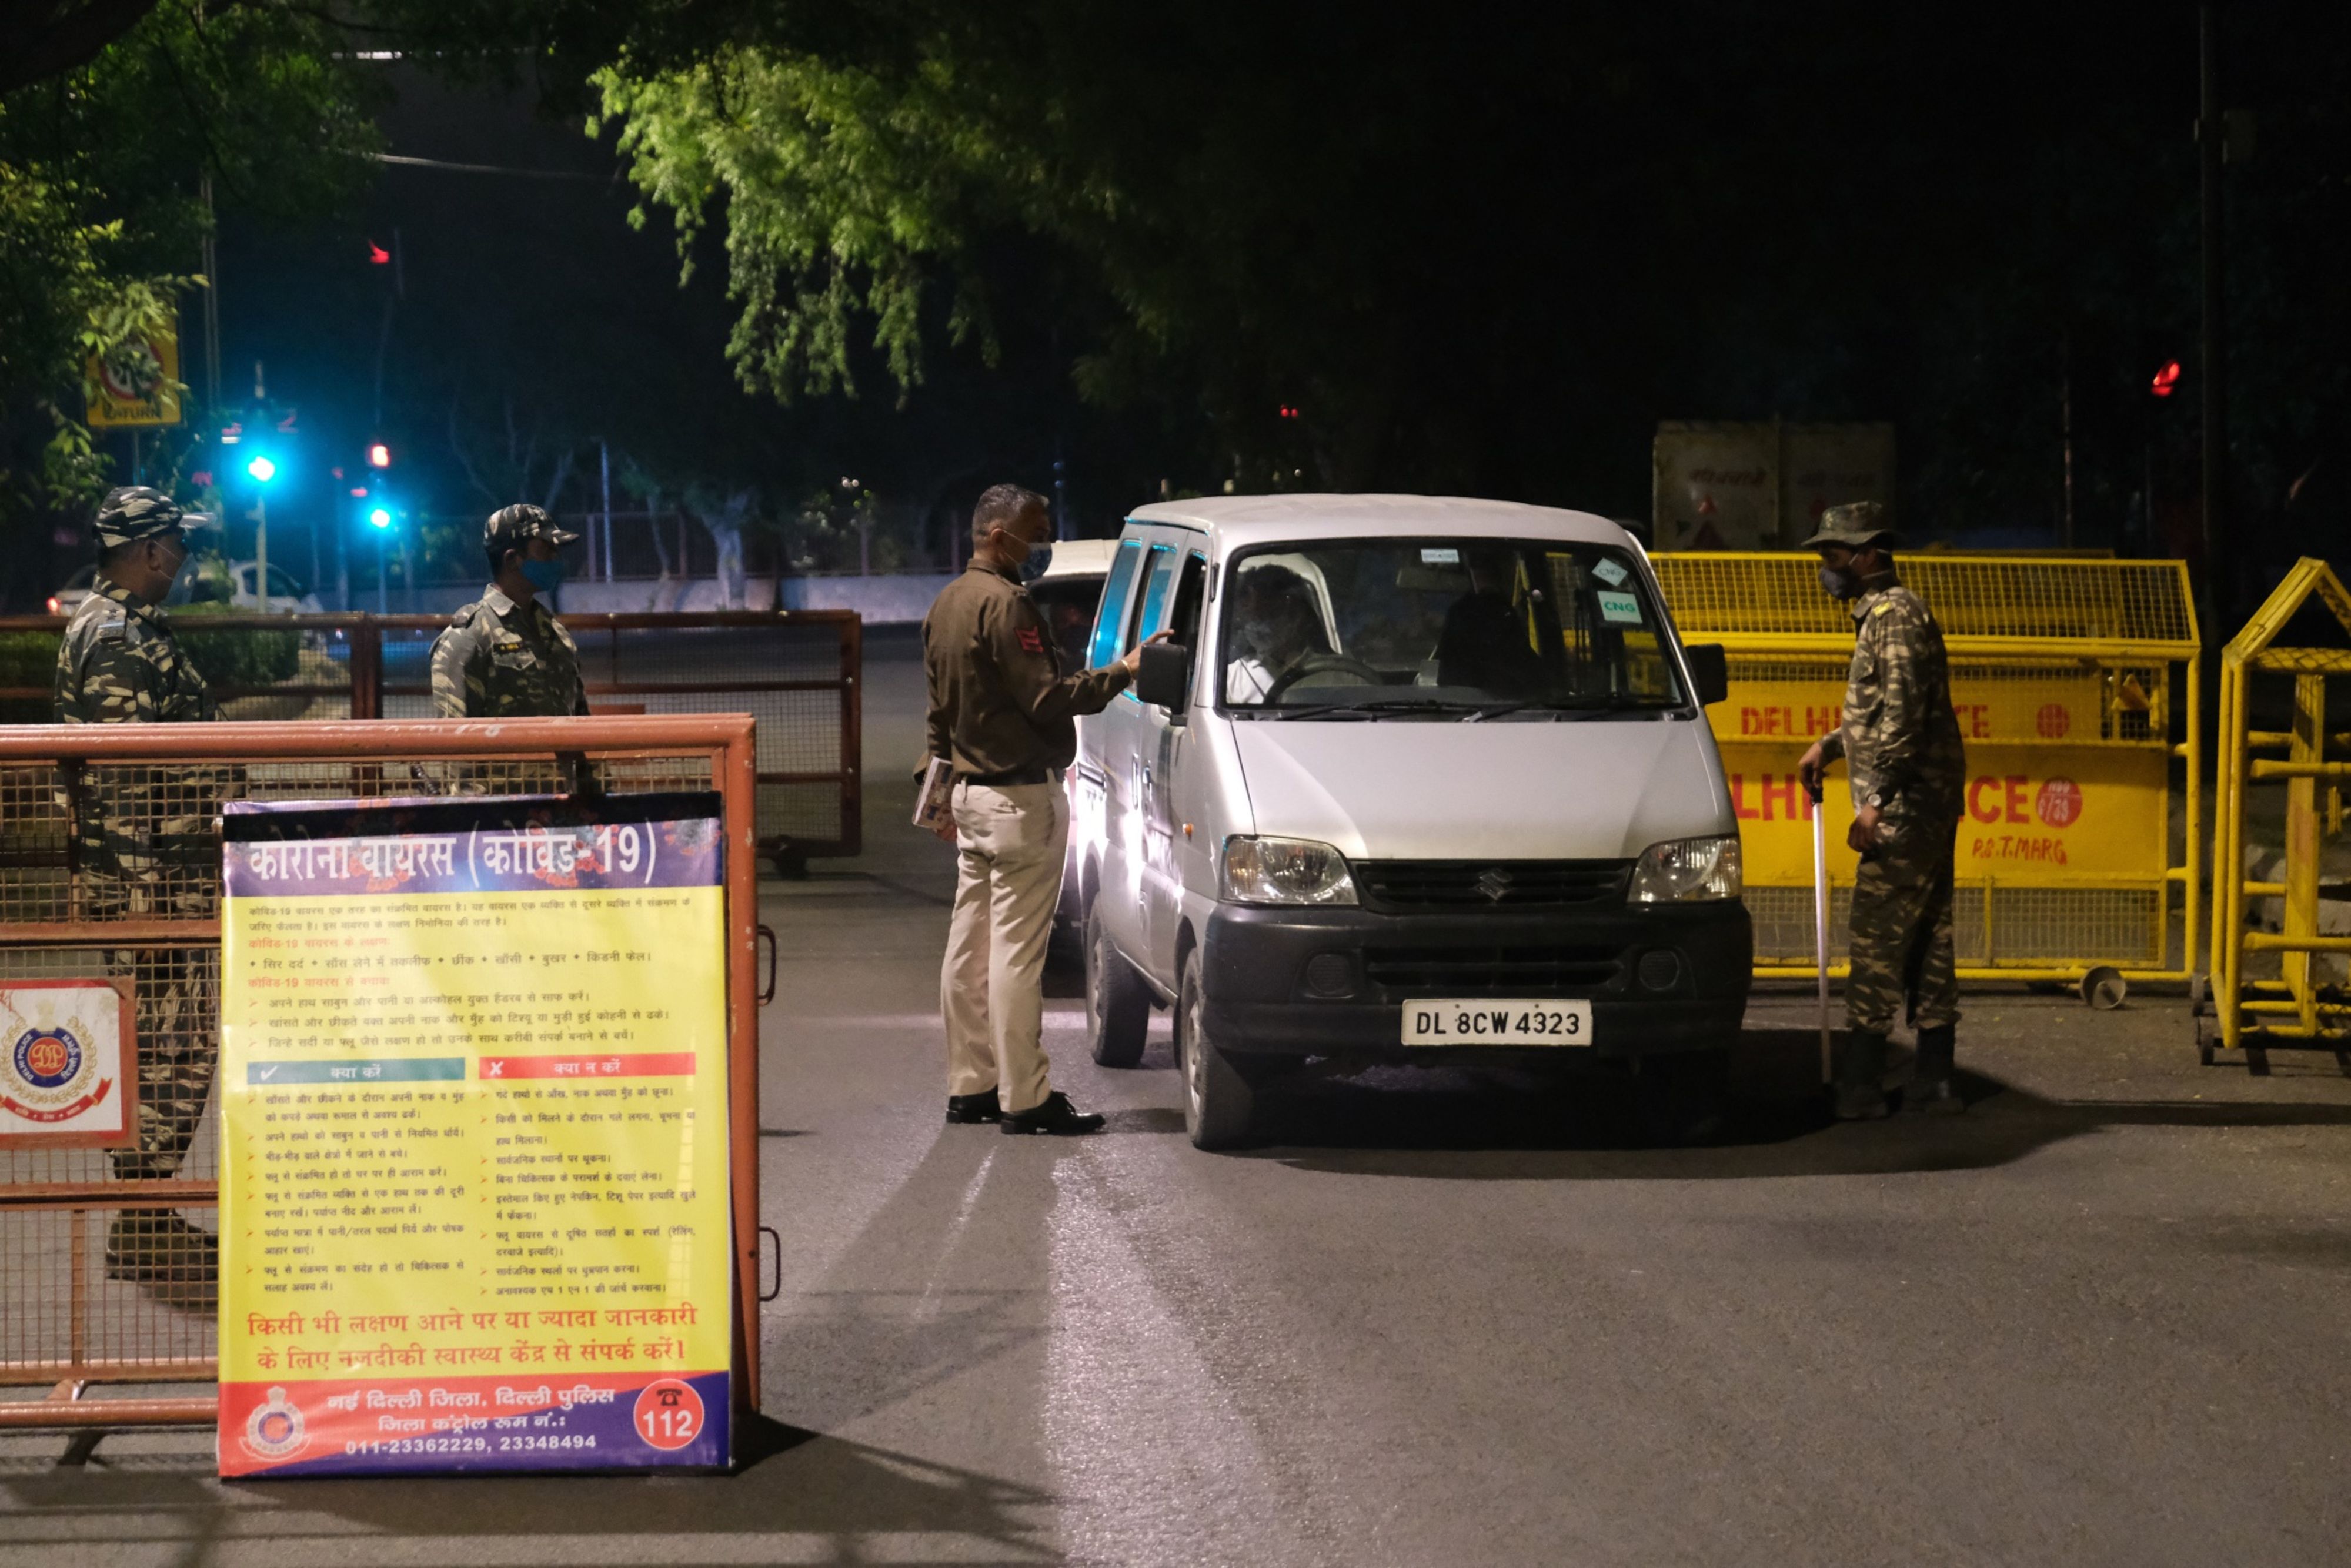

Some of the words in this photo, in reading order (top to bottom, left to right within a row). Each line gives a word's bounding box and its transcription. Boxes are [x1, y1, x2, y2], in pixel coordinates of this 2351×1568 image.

[1604, 601, 1635, 613] CNG
[1741, 706, 1841, 735] DELHI
[361, 836, 457, 878] वायरस
[1416, 1012, 1447, 1034] DL
[1456, 1011, 1508, 1034] 8CW
[1514, 1012, 1580, 1035] 4323
[330, 1068, 359, 1078] क्या
[361, 1064, 382, 1078] करें
[553, 1063, 580, 1074] क्या
[585, 1063, 597, 1074] न
[601, 1059, 622, 1072] करें
[246, 1311, 306, 1335] किसी
[312, 1310, 342, 1334] भी
[348, 1315, 409, 1333] लक्षण
[418, 1307, 465, 1331] आने
[470, 1312, 499, 1330] पर
[504, 1312, 532, 1329] या
[537, 1310, 598, 1328] ज्यादा
[604, 1302, 699, 1326] जानकारी
[256, 1346, 279, 1369] के
[286, 1345, 331, 1371] लिए
[433, 1348, 503, 1365] स्वास्थ्य
[509, 1339, 547, 1363] केंद्र
[553, 1338, 573, 1362] से
[579, 1337, 636, 1361] संपर्क
[642, 1336, 685, 1359] करें।
[323, 1390, 362, 1412] नई
[365, 1389, 423, 1410] दिल्ली
[494, 1386, 553, 1407] दिल्ली
[556, 1384, 616, 1412] पुलिस
[643, 1410, 693, 1437] 112
[345, 1438, 492, 1456] 011-23362229,
[499, 1435, 597, 1450] 23348494
